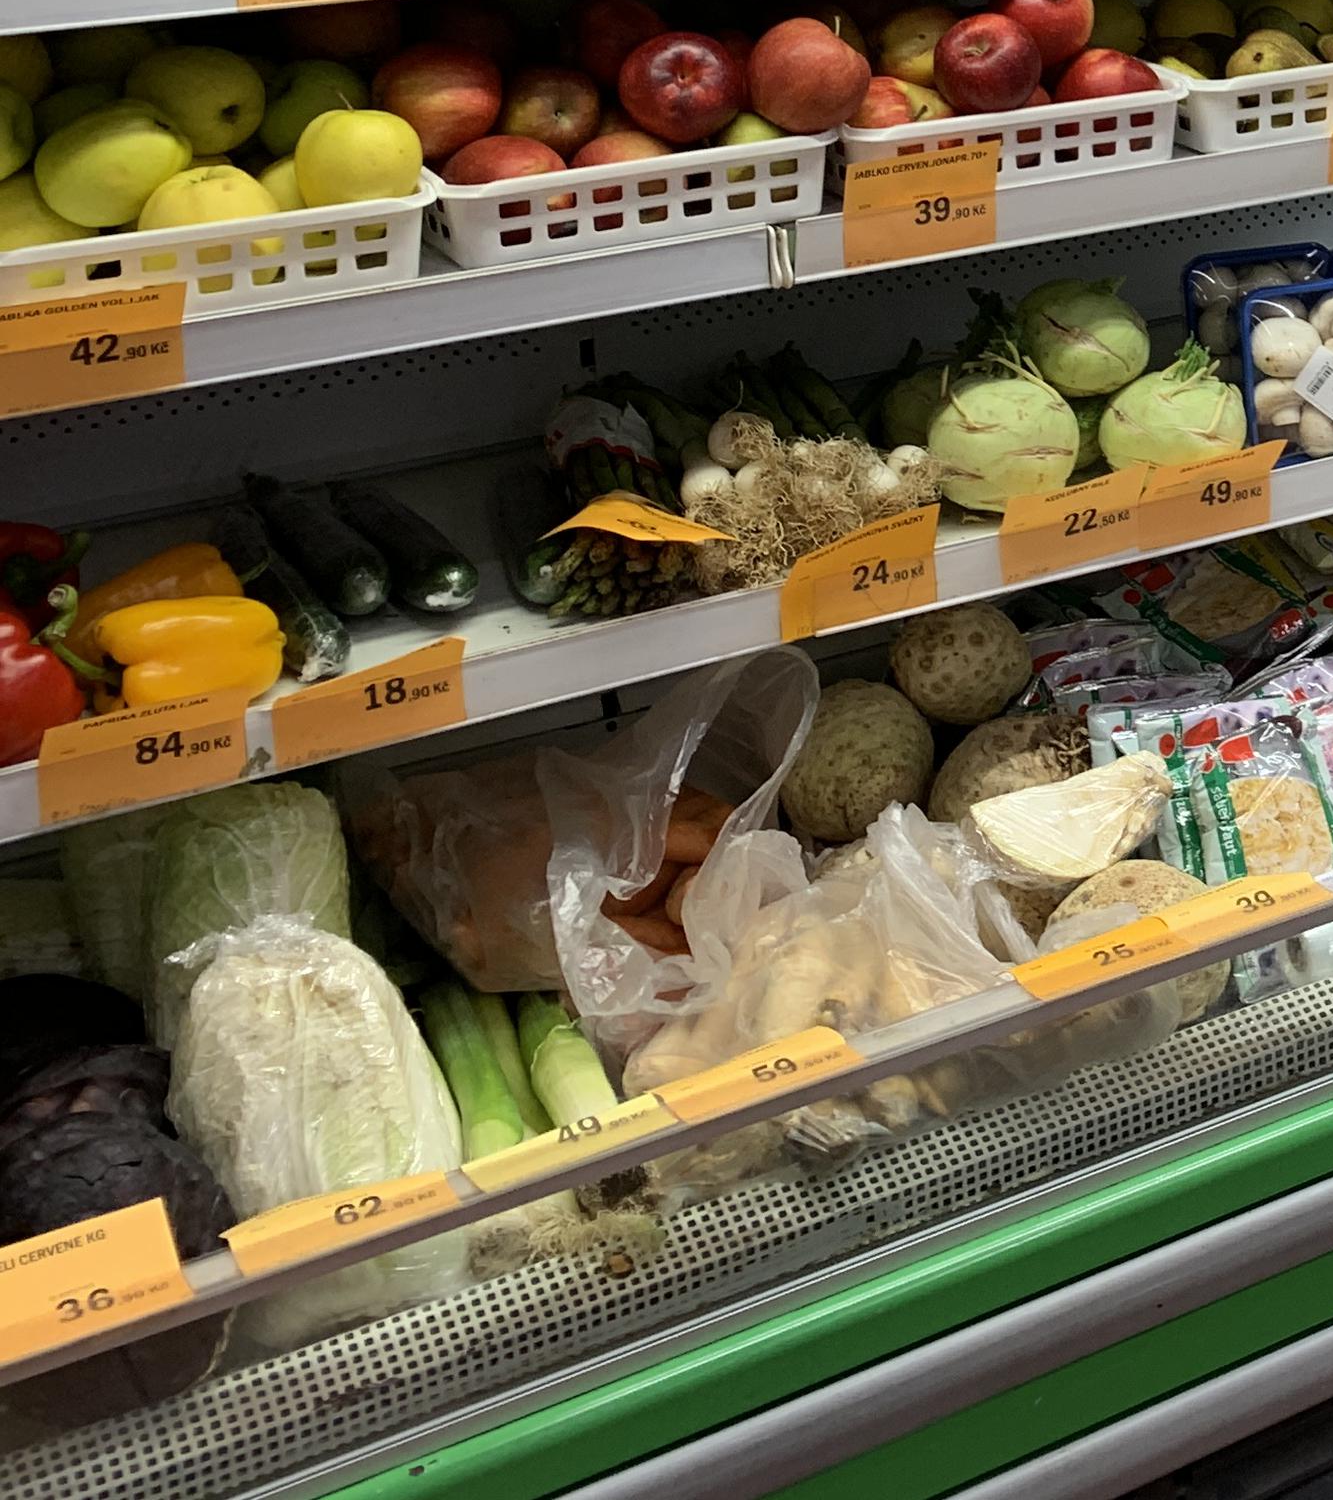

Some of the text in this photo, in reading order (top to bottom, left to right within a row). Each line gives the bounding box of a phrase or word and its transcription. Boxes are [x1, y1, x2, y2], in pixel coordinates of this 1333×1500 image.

[854, 165, 890, 180] JABLKO
[973, 204, 987, 216] Kč
[0, 302, 98, 322] ABLKA GOLDEN
[150, 341, 169, 355] Kč
[1118, 511, 1130, 521] Kč
[433, 680, 450, 693] Kč
[214, 735, 231, 751] Kč
[19, 1229, 107, 1267] CERVENE KG
